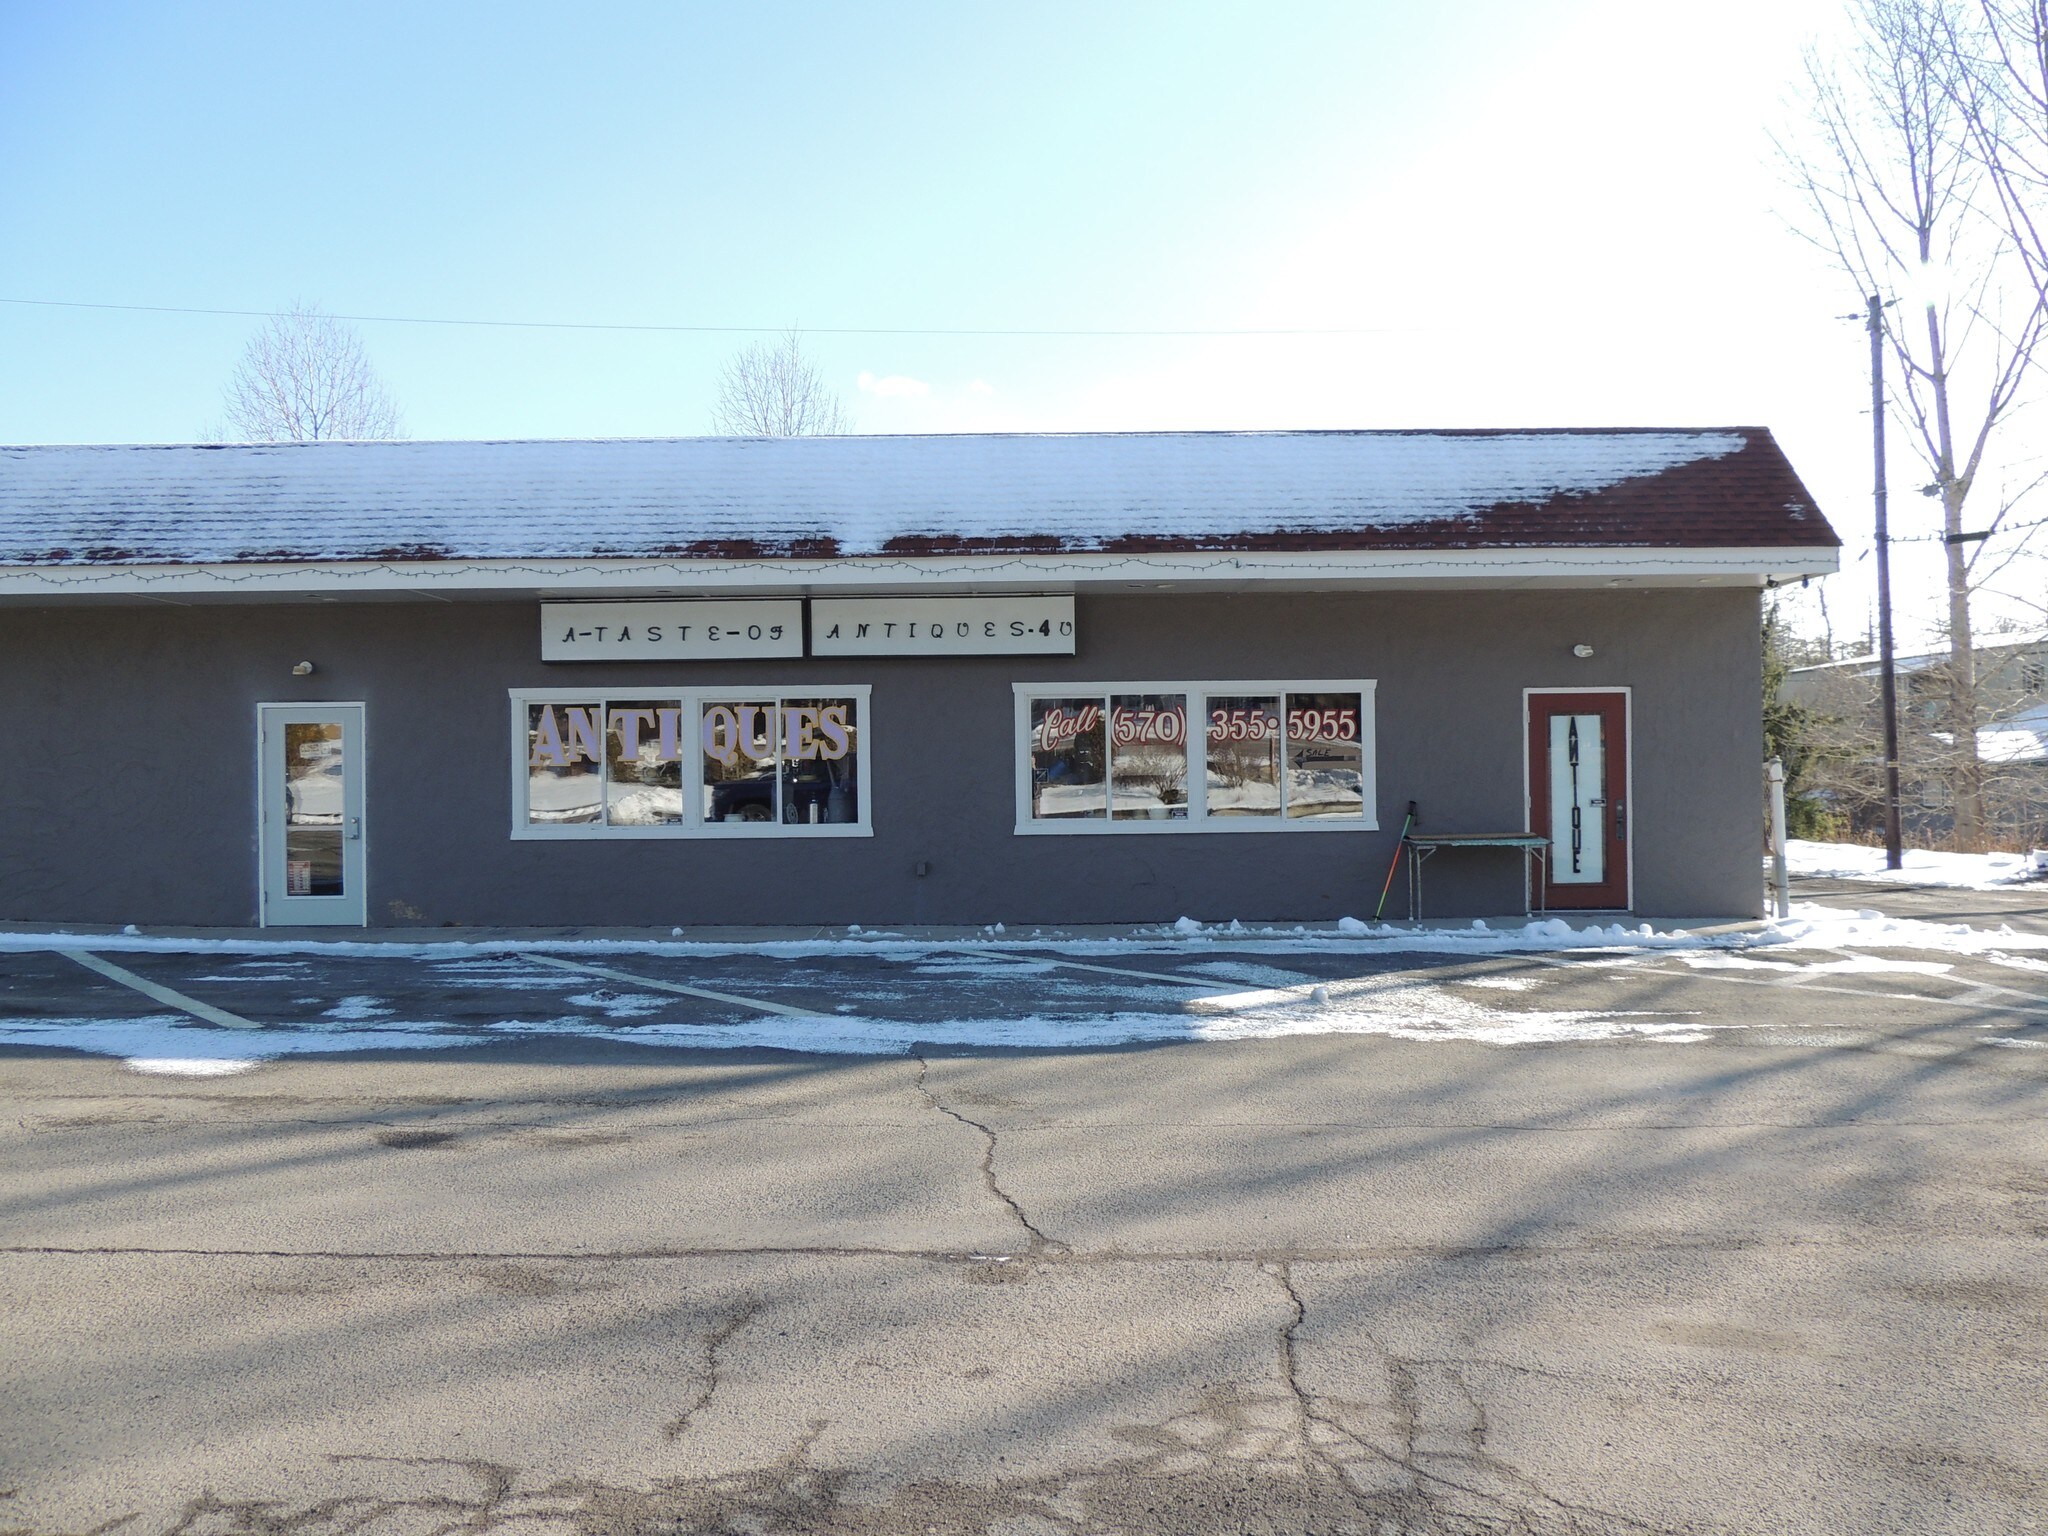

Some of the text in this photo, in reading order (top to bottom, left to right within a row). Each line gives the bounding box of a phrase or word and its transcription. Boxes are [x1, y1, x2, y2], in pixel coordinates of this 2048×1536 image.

[529, 704, 848, 766] ANTIQUES
[1041, 705, 1098, 751] Call
[1110, 705, 1188, 747] (570)
[1306, 748, 1331, 757] SALE
